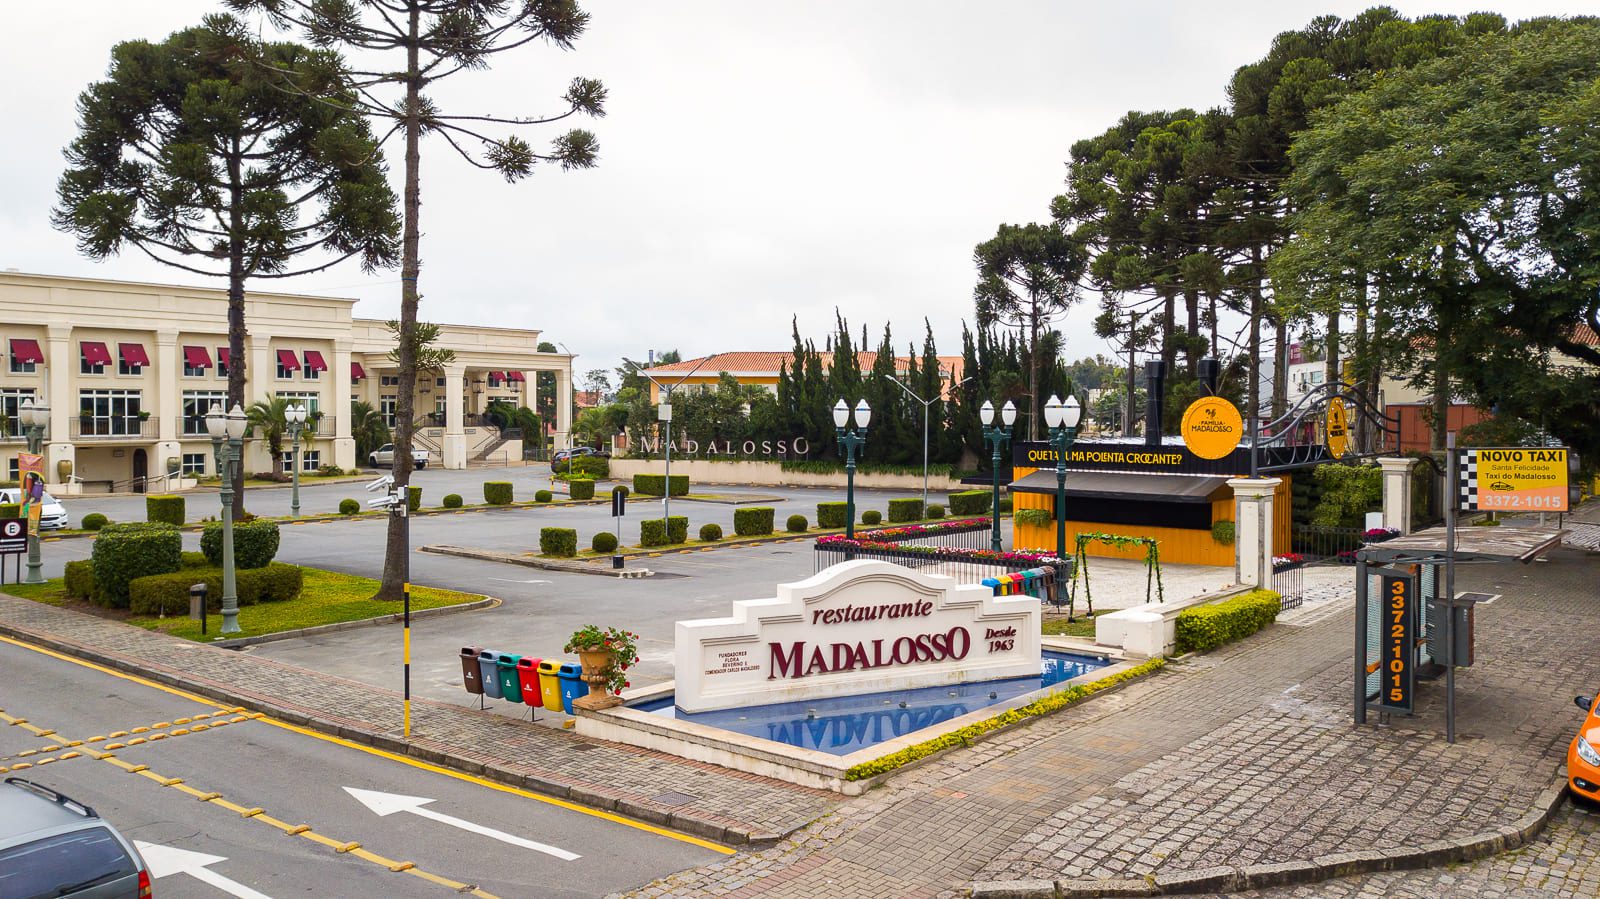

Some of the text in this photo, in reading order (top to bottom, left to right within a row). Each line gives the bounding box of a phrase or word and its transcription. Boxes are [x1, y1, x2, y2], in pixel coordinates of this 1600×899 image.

[640, 436, 809, 454] MADALOSSO
[1086, 452, 1125, 463] POLENTA
[1127, 453, 1182, 464] CROCANTE?
[1482, 451, 1562, 462] NOVO TAXI
[1485, 496, 1561, 507] 3372-1015
[10, 524, 16, 533] E
[812, 598, 933, 625] restaurante
[984, 626, 1016, 640] Desde
[767, 626, 971, 680] MADALOSSO
[988, 640, 1014, 654] 1963
